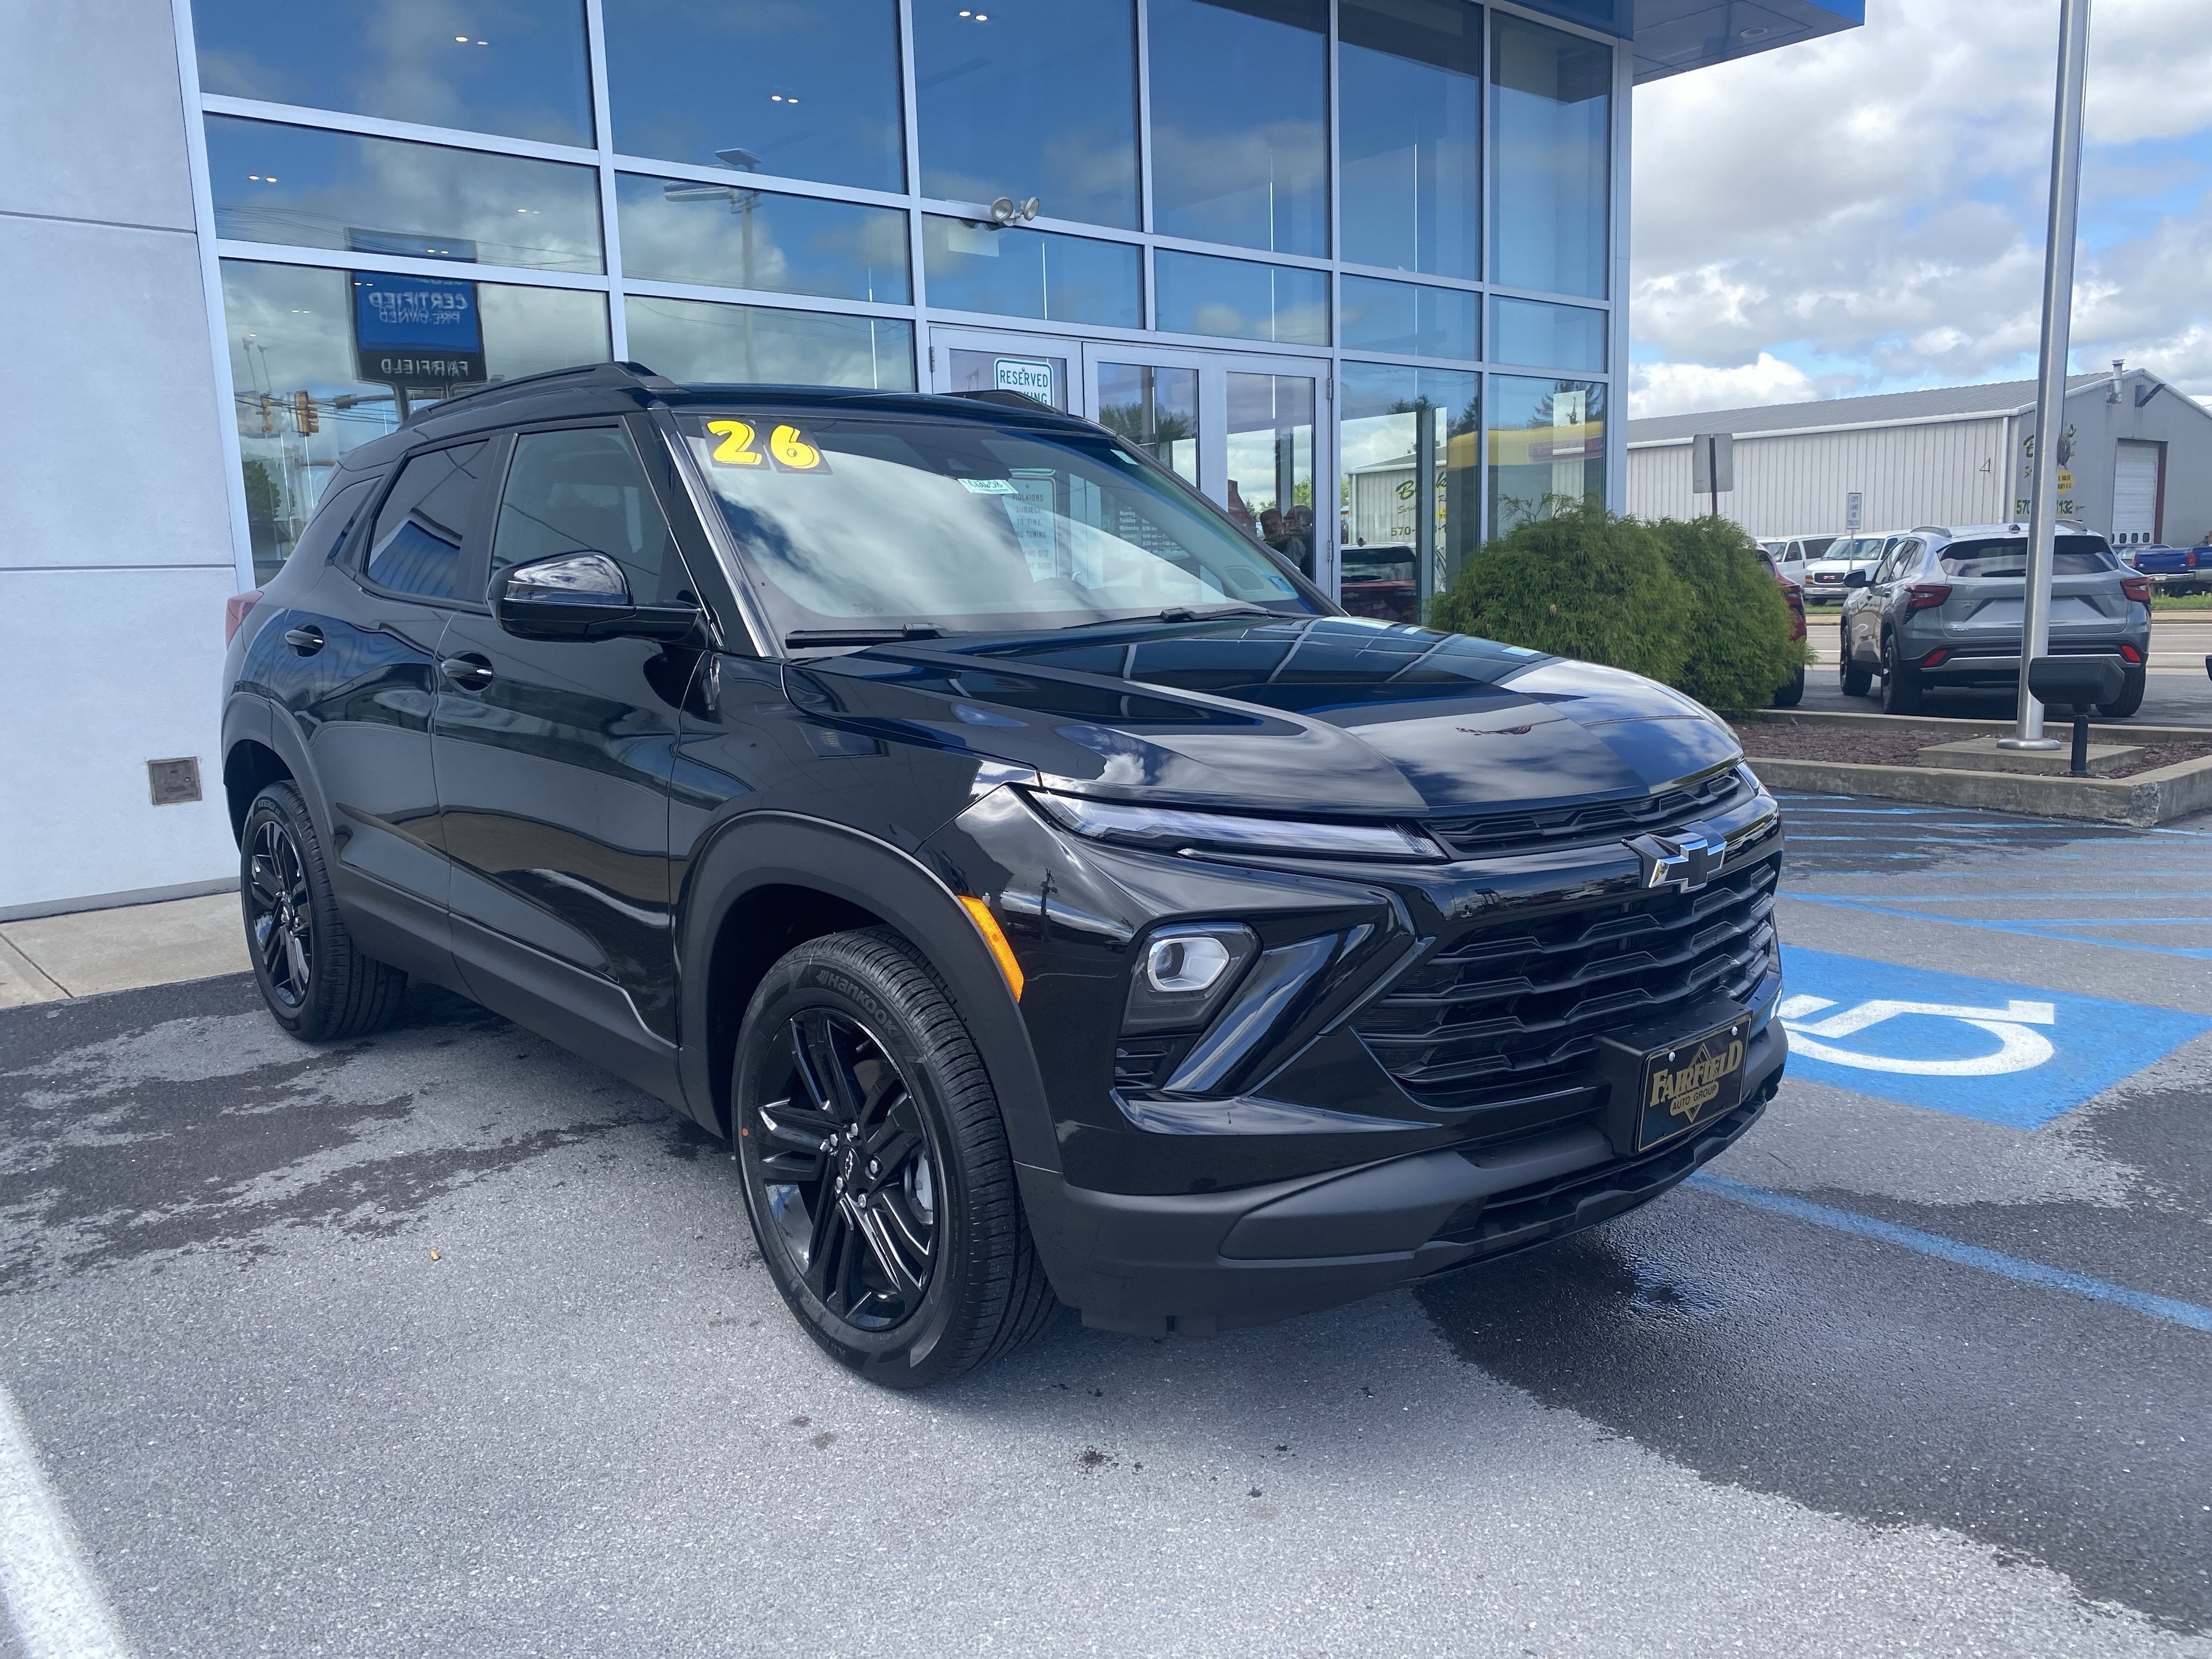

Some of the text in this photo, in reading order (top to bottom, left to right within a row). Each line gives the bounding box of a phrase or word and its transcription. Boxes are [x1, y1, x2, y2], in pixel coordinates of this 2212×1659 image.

[1000, 369, 1048, 387] RESERVED
[707, 420, 820, 469] 26
[1012, 493, 1043, 501] VIOLATORS
[1650, 1039, 1743, 1107] FAIRFIELD
[1672, 1084, 1717, 1111] AUTO GROUP
